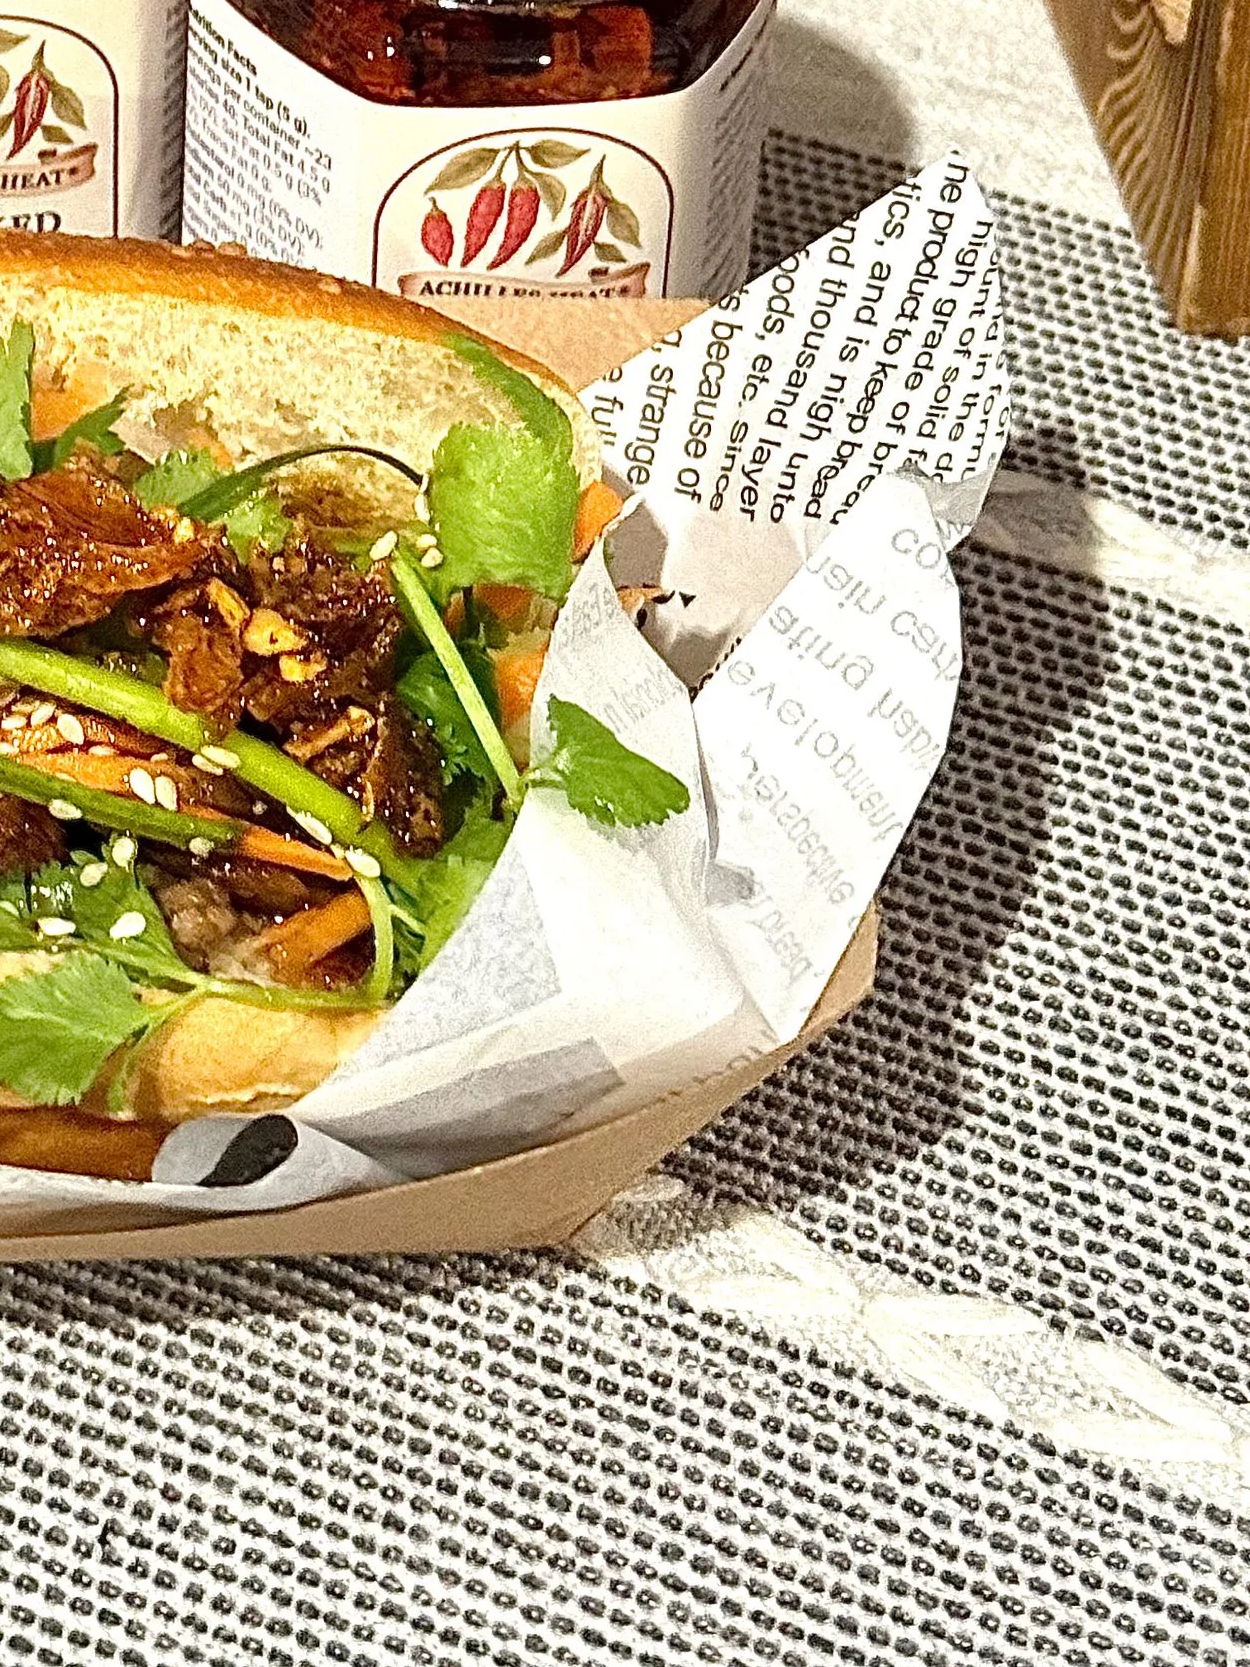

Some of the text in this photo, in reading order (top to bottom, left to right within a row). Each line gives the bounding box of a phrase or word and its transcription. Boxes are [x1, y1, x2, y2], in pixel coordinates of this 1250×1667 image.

[853, 260, 892, 328] and
[738, 353, 774, 408] etc.
[803, 208, 956, 520] product to keep bread
[838, 335, 871, 363] is
[905, 296, 958, 392] grade
[684, 319, 744, 460] because
[740, 277, 848, 523] thousand layer
[885, 400, 911, 436] of
[915, 326, 976, 440] of solid
[949, 392, 980, 442] the
[624, 363, 678, 486] strange
[674, 466, 702, 505] of
[769, 451, 810, 524] unto
